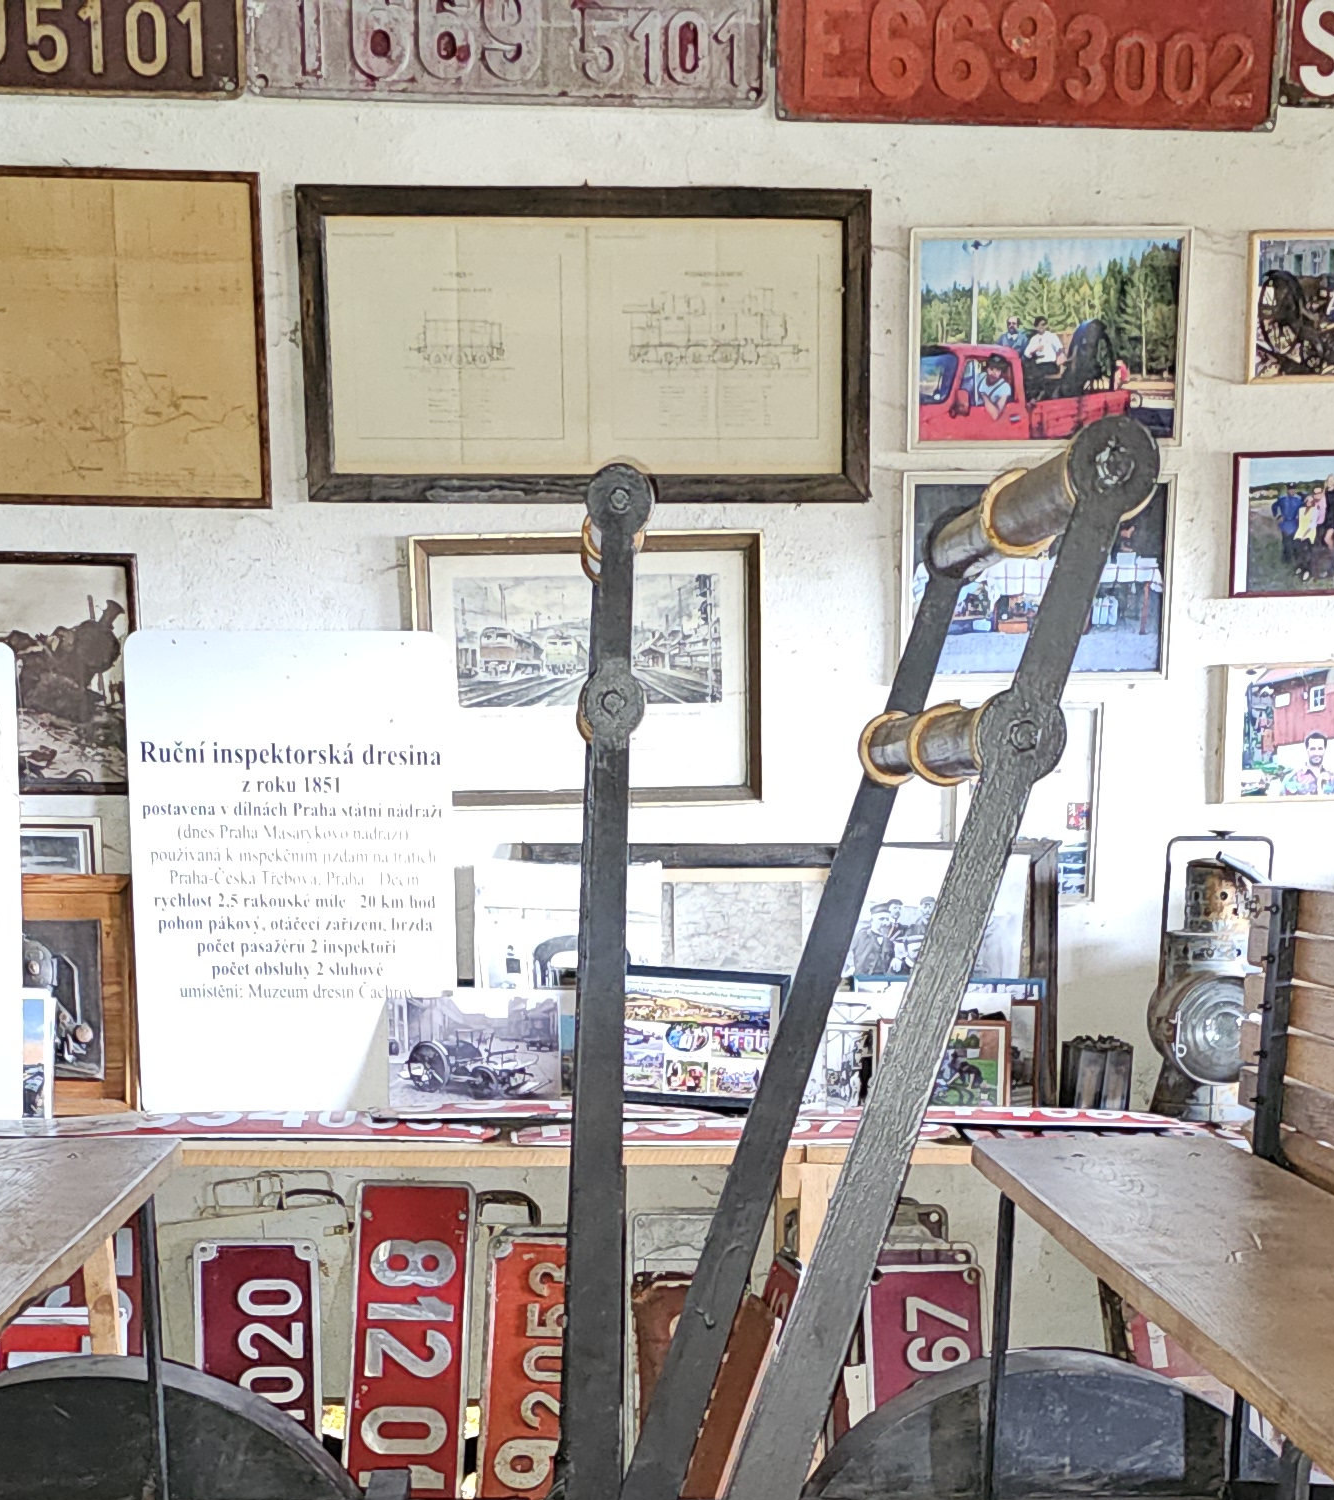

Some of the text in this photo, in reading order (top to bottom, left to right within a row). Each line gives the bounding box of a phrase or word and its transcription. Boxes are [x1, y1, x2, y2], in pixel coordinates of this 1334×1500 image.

[803, 0, 1254, 108] E6693002
[140, 740, 442, 771] Ruční inspektorská dresina
[242, 776, 341, 793] z roku 1851
[142, 803, 216, 819] postavena
[221, 805, 228, 816] v
[234, 801, 288, 817] dílnách
[294, 802, 337, 817] Praha
[220, 824, 259, 839] Praha
[226, 848, 233, 862] k
[154, 893, 212, 911] rychlost
[244, 894, 310, 909] rakouské
[158, 916, 203, 934] pohon
[391, 917, 433, 932] brzda
[197, 940, 235, 957] počet
[311, 940, 319, 953] 2
[212, 962, 384, 979] počet obsluhy 2 sluhové
[249, 984, 309, 999] Muzeum
[313, 984, 354, 999] dresin
[237, 1279, 306, 1421] 020
